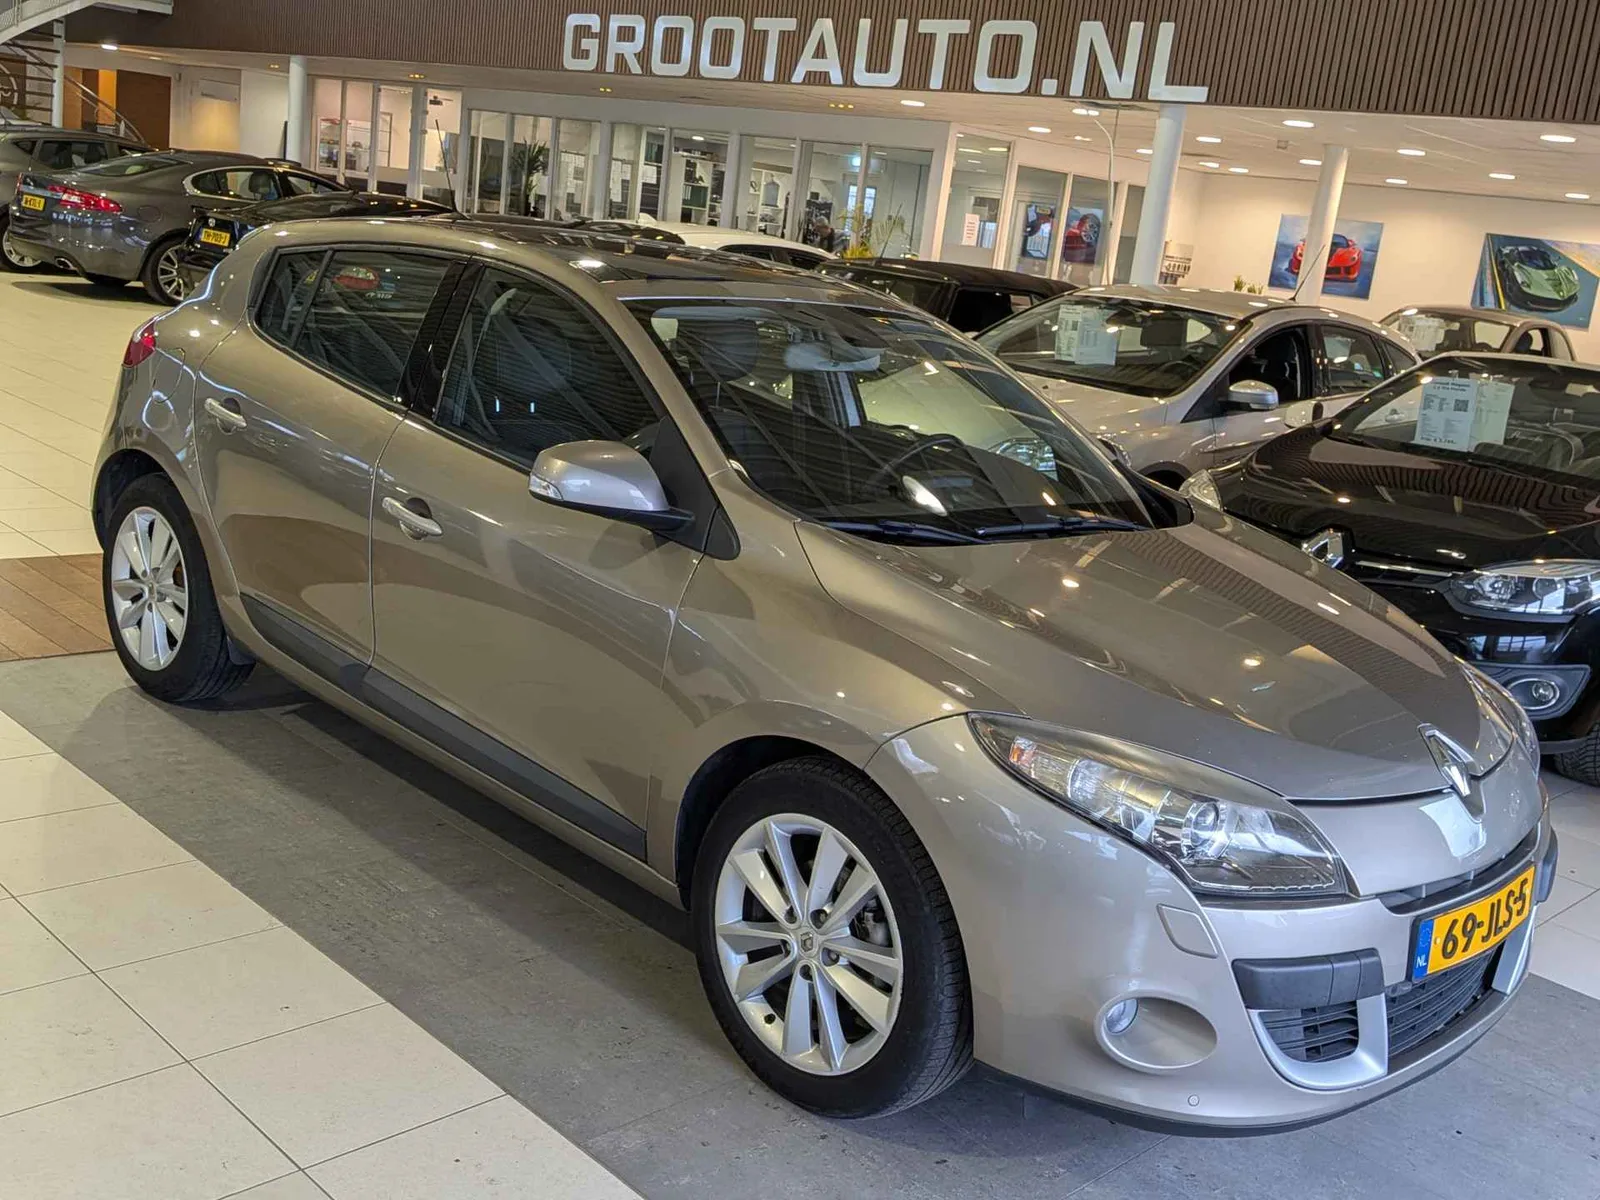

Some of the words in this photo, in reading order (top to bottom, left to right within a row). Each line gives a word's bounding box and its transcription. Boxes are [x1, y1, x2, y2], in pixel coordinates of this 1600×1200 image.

[563, 13, 1209, 103] GROOTAUTO.NL
[1441, 877, 1529, 960] 69-JLS-5
[1415, 954, 1427, 969] NL
